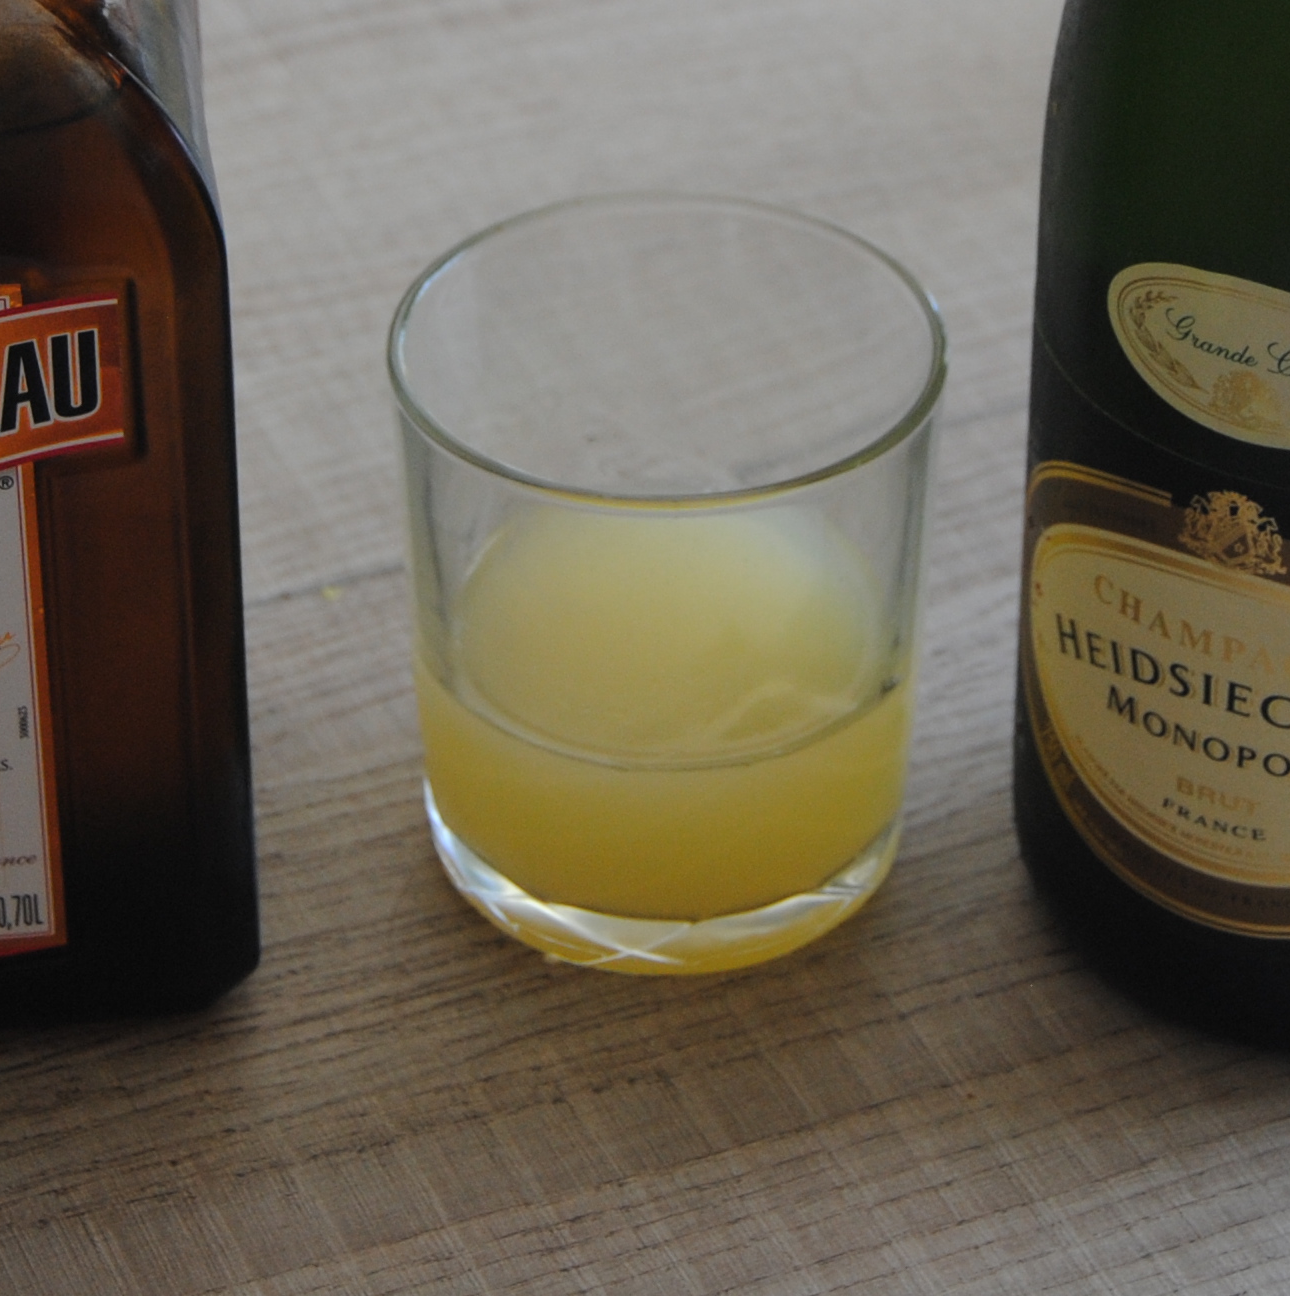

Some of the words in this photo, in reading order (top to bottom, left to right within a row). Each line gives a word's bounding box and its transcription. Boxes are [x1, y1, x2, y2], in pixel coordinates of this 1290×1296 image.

[1165, 307, 1258, 368] Grande
[1176, 775, 1261, 817] BRUT
[1163, 798, 1268, 843] FRANCE
